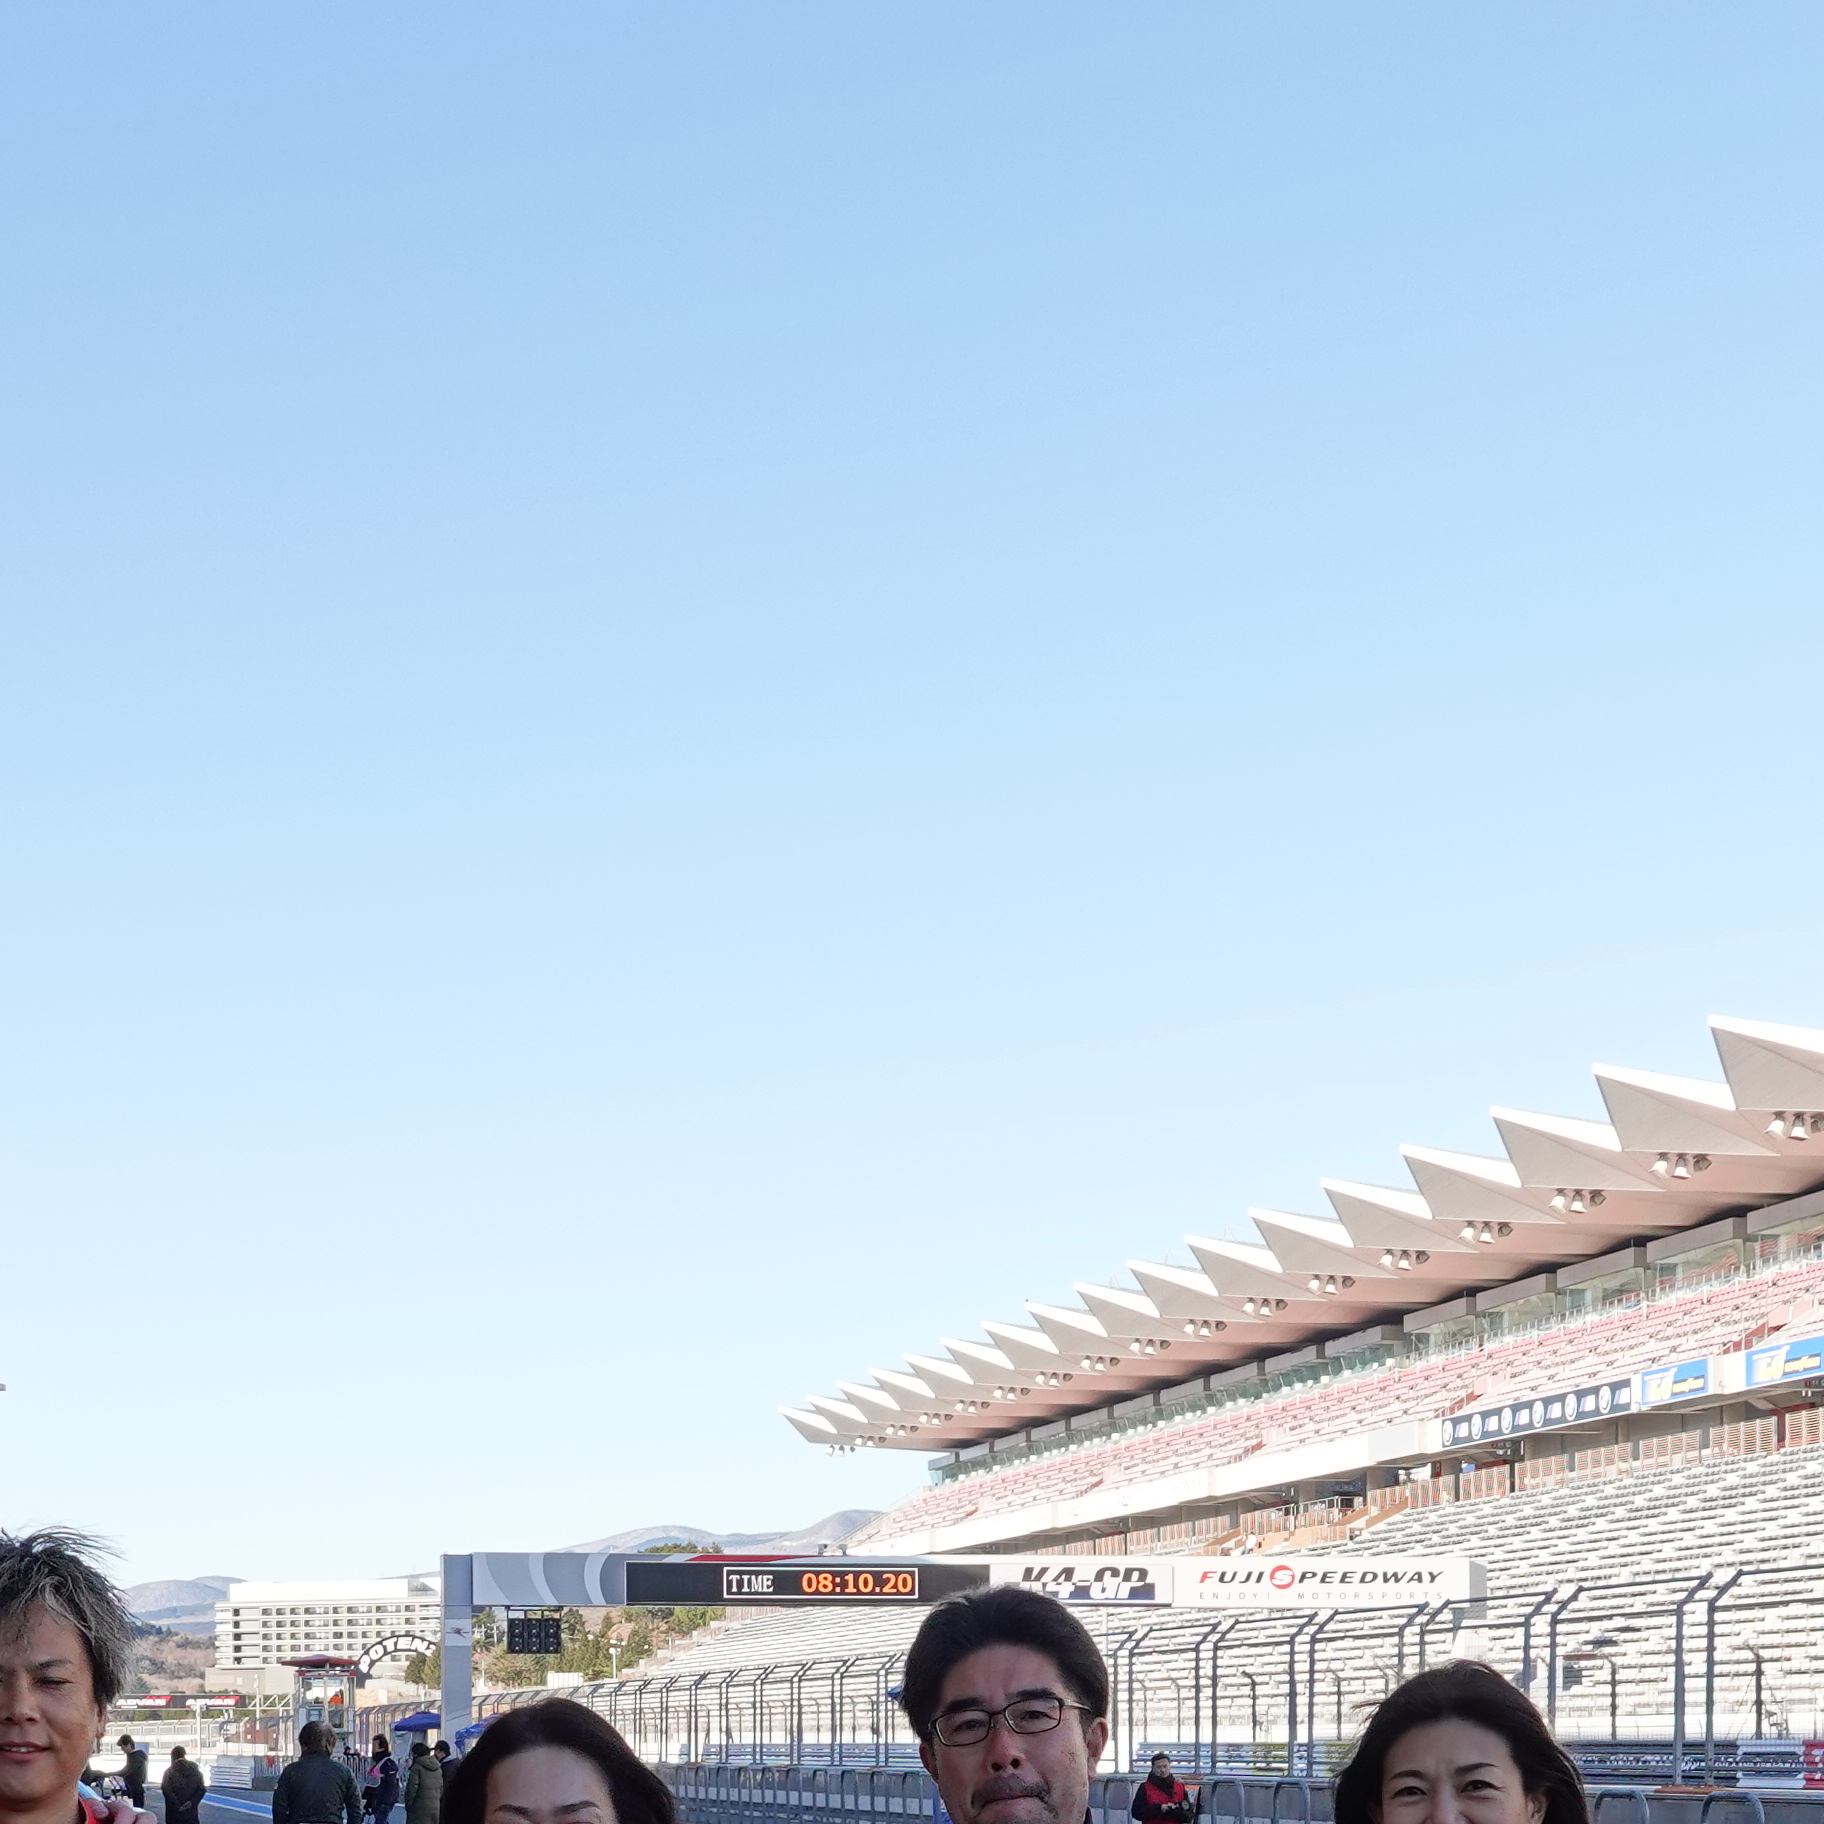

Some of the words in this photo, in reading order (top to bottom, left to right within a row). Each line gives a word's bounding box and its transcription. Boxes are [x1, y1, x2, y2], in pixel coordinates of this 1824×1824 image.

[728, 1574, 774, 1593] TIME
[801, 1572, 914, 1594] 08:10.20
[1019, 1566, 1149, 1600] K4-GP
[1199, 1570, 1266, 1585] FUJI
[1269, 1565, 1445, 1590] SPEEDWAY
[1199, 1592, 1271, 1601] ENJOY!
[1297, 1591, 1444, 1601] MOTORSPORTS
[116, 1698, 166, 1706] ADVAN
[185, 1698, 236, 1706] ADVAN
